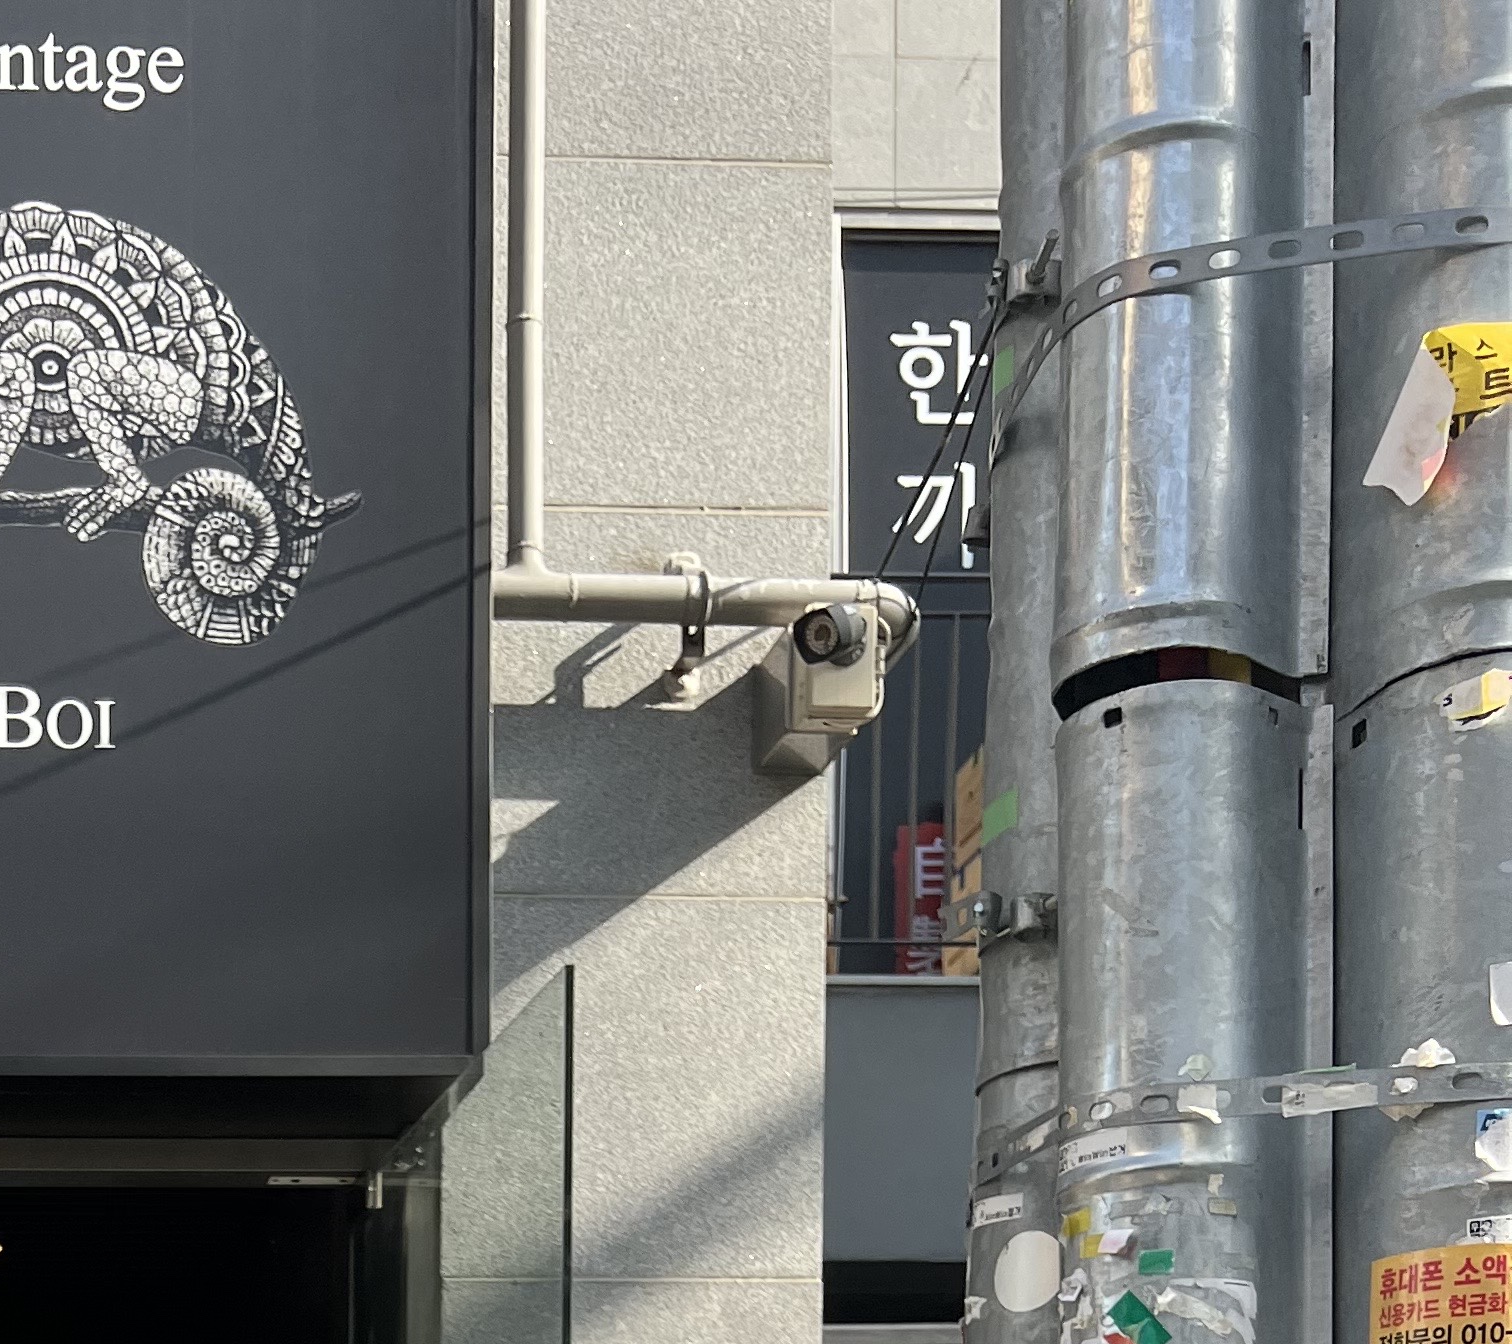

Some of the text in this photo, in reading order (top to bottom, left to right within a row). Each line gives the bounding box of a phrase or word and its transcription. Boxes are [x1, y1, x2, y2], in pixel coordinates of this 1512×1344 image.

[1380, 1254, 1512, 1300] 휴대폰 소액
[1379, 1292, 1508, 1329] 신용카드 현금화
